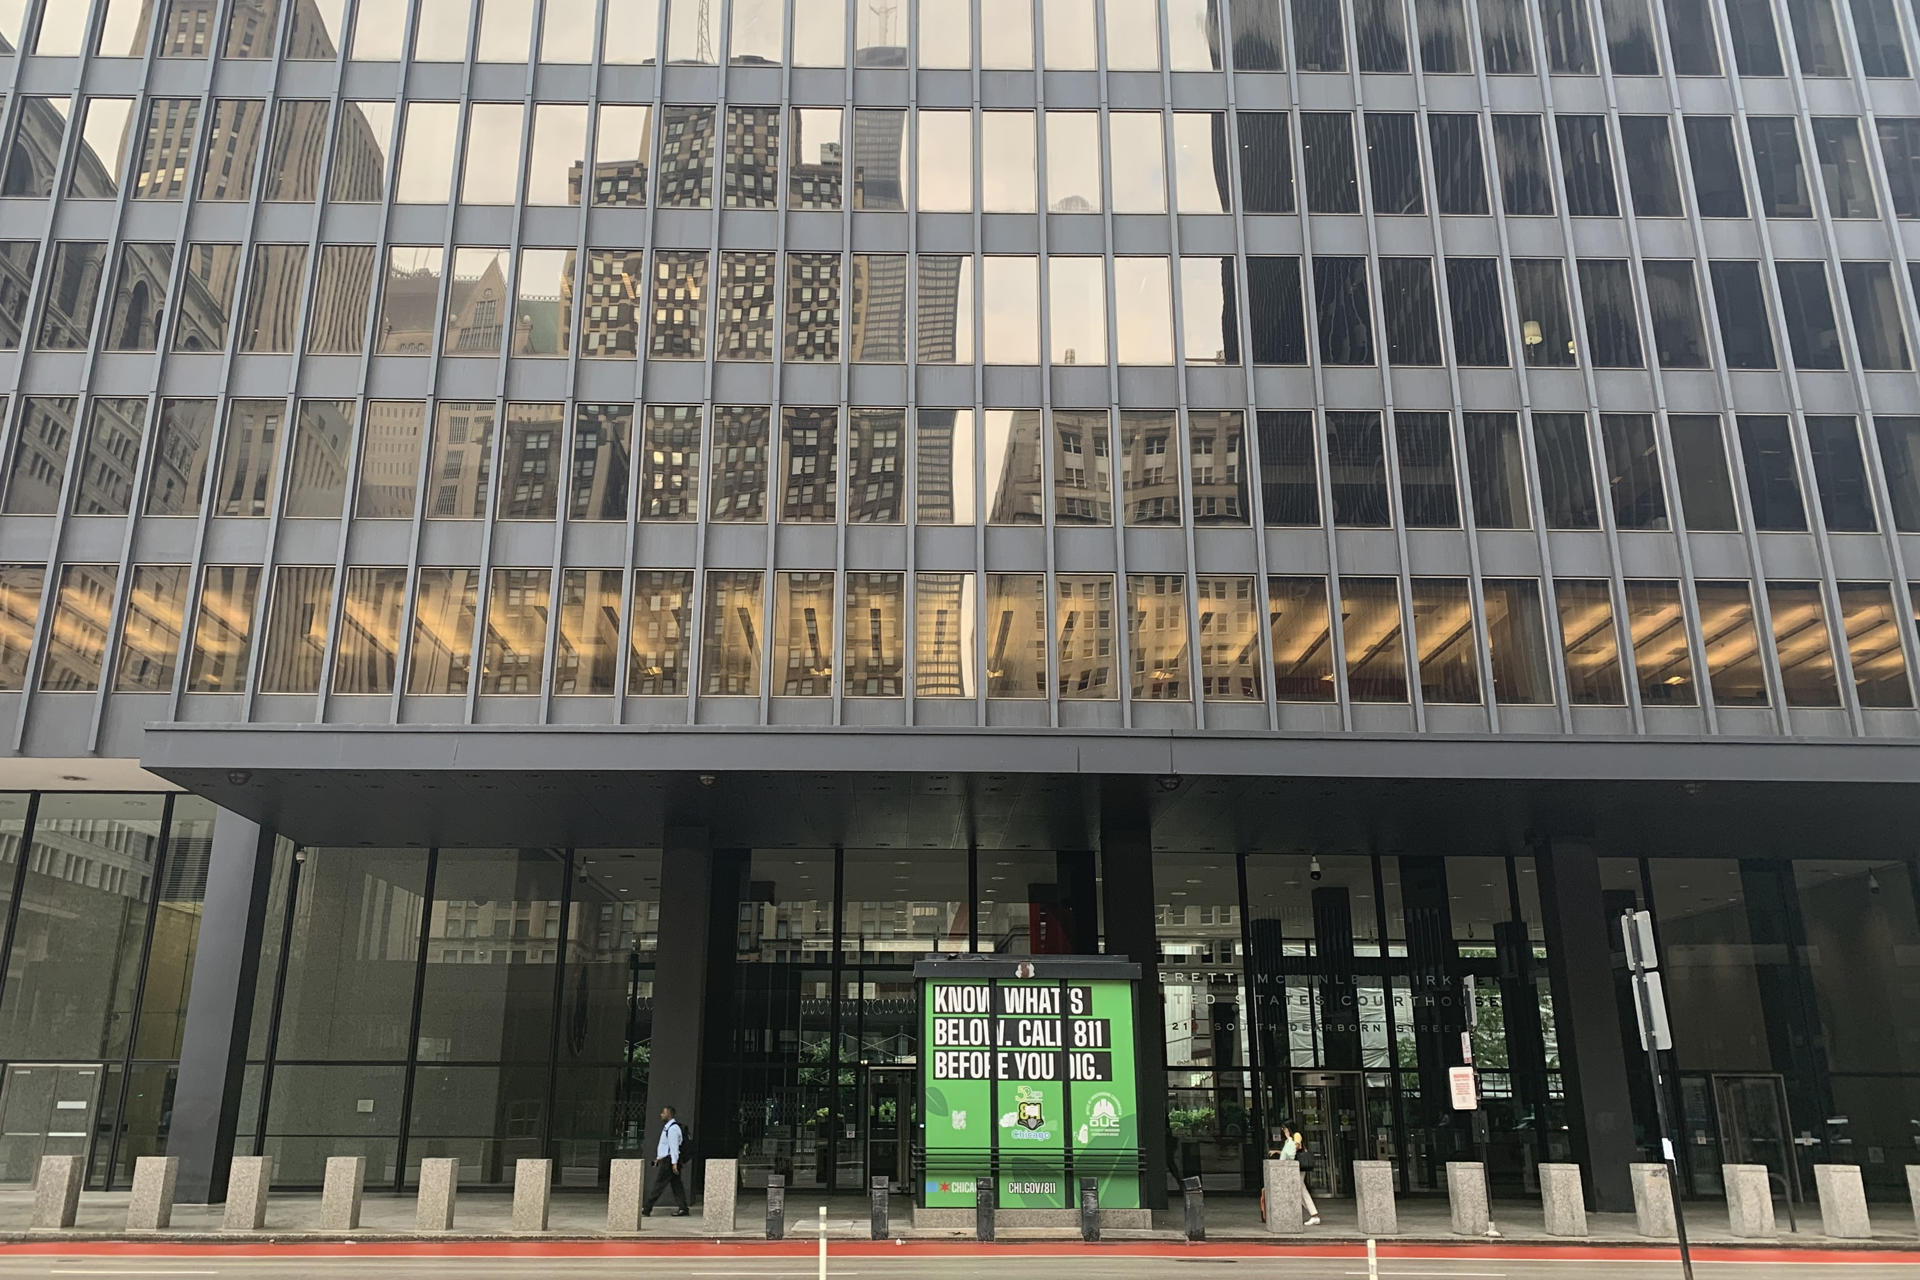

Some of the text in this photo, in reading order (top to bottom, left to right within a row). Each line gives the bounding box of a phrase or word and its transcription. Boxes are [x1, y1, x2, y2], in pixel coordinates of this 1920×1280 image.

[1399, 975, 1501, 987] DIRKEN
[934, 986, 1083, 1014] KNOW WHAT'S
[934, 1018, 1012, 1046] BELOW.
[1074, 1020, 1103, 1047] 811
[1290, 1023, 1381, 1033] DEARBORN
[934, 1051, 1009, 1079] BEFORE
[1014, 1052, 1055, 1079] YOU
[951, 1181, 978, 1194] CHICA
[1008, 1182, 1056, 1194] CHI.GOV/811
